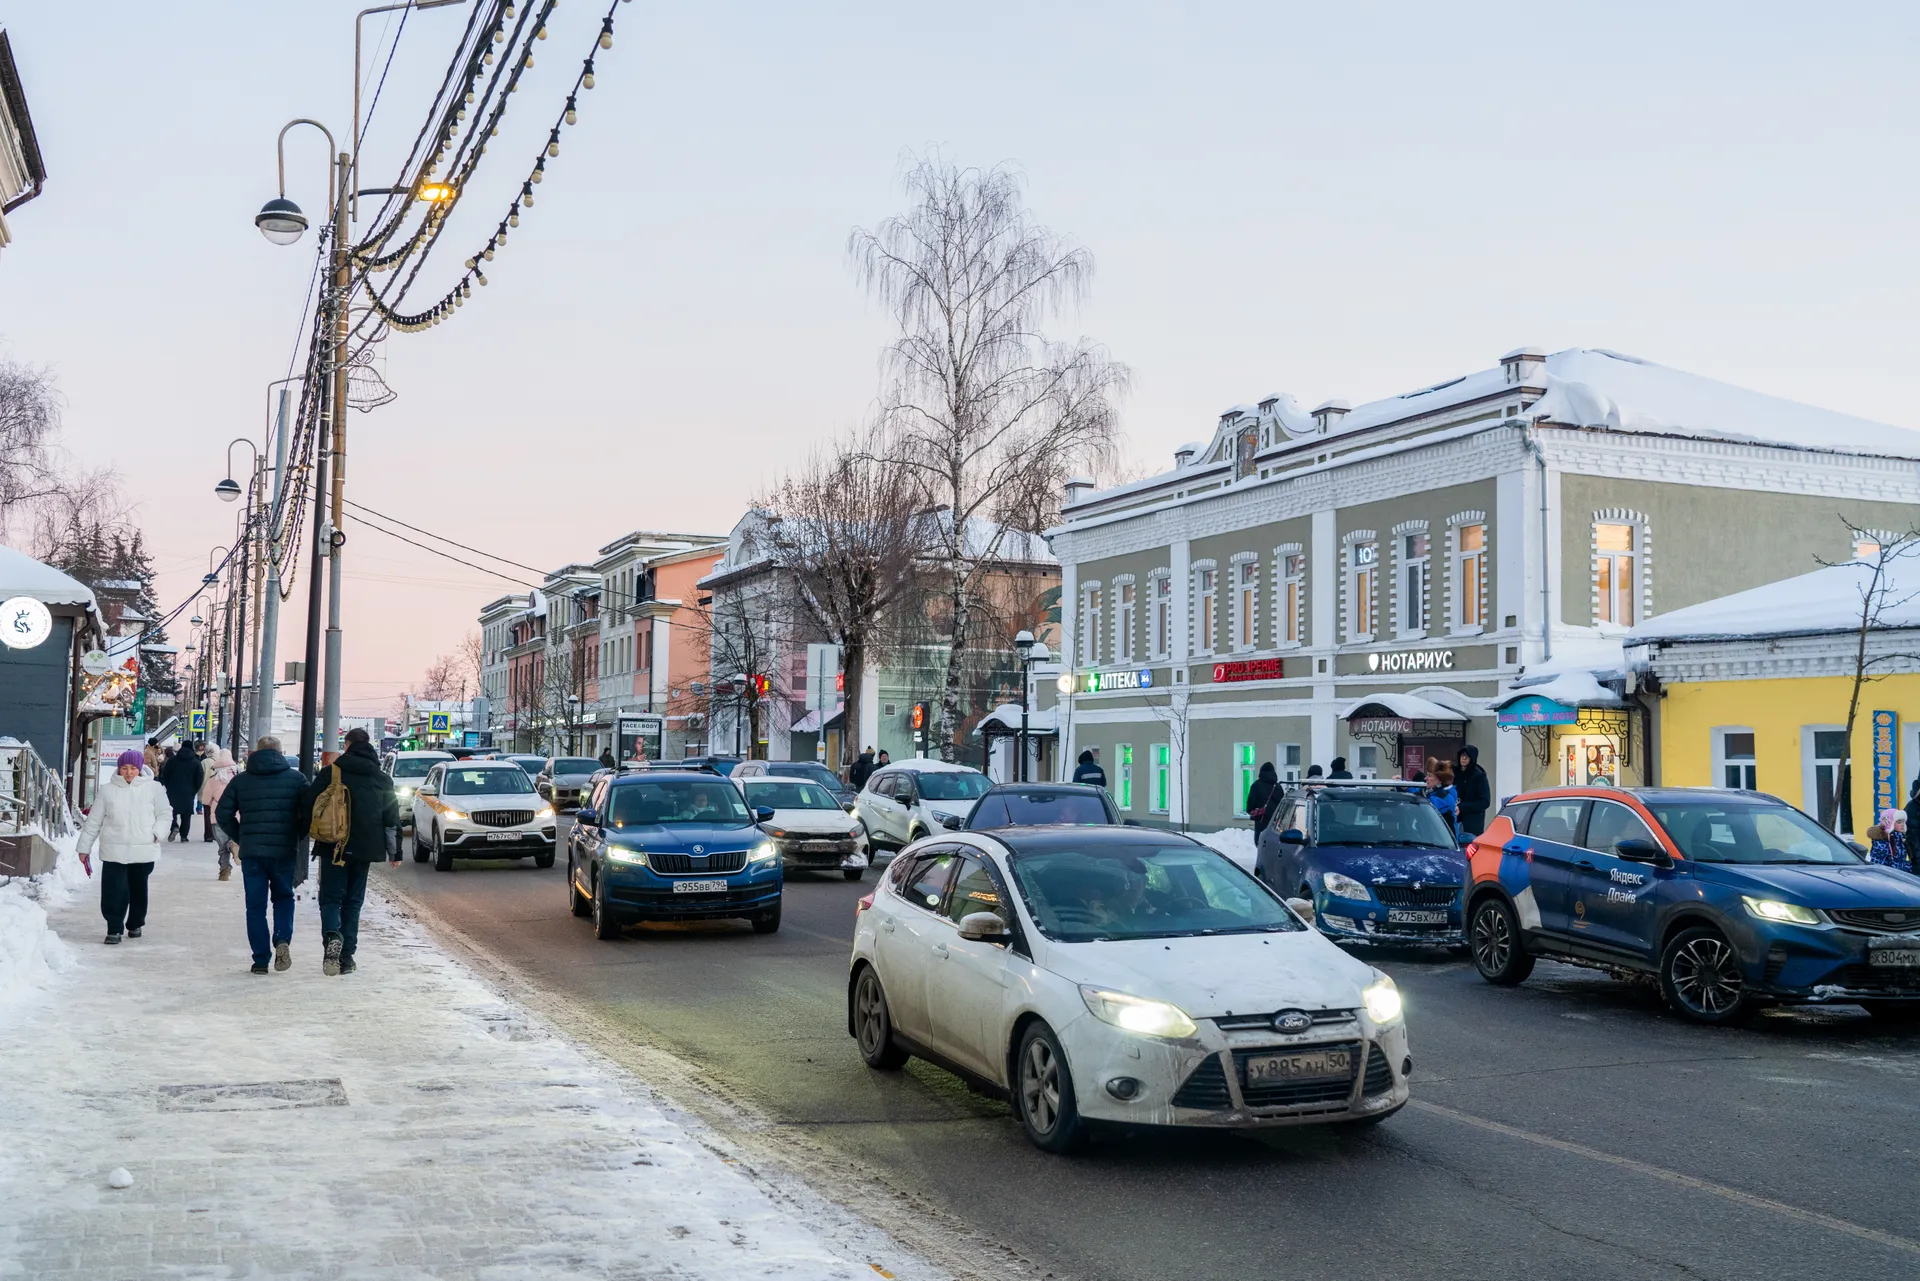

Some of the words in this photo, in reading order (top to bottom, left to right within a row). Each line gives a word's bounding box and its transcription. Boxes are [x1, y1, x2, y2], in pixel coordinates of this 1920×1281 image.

[1382, 651, 1452, 671] НОТАРИУС
[1099, 671, 1138, 689] АПТЕКА
[1361, 720, 1410, 732] НОТАРИУС
[1876, 713, 1892, 812] ФЕЙЕРВЕ
[1610, 867, 1643, 885] Яндекс
[1607, 887, 1636, 904] Драйв
[1284, 1018, 1303, 1027] Ford
